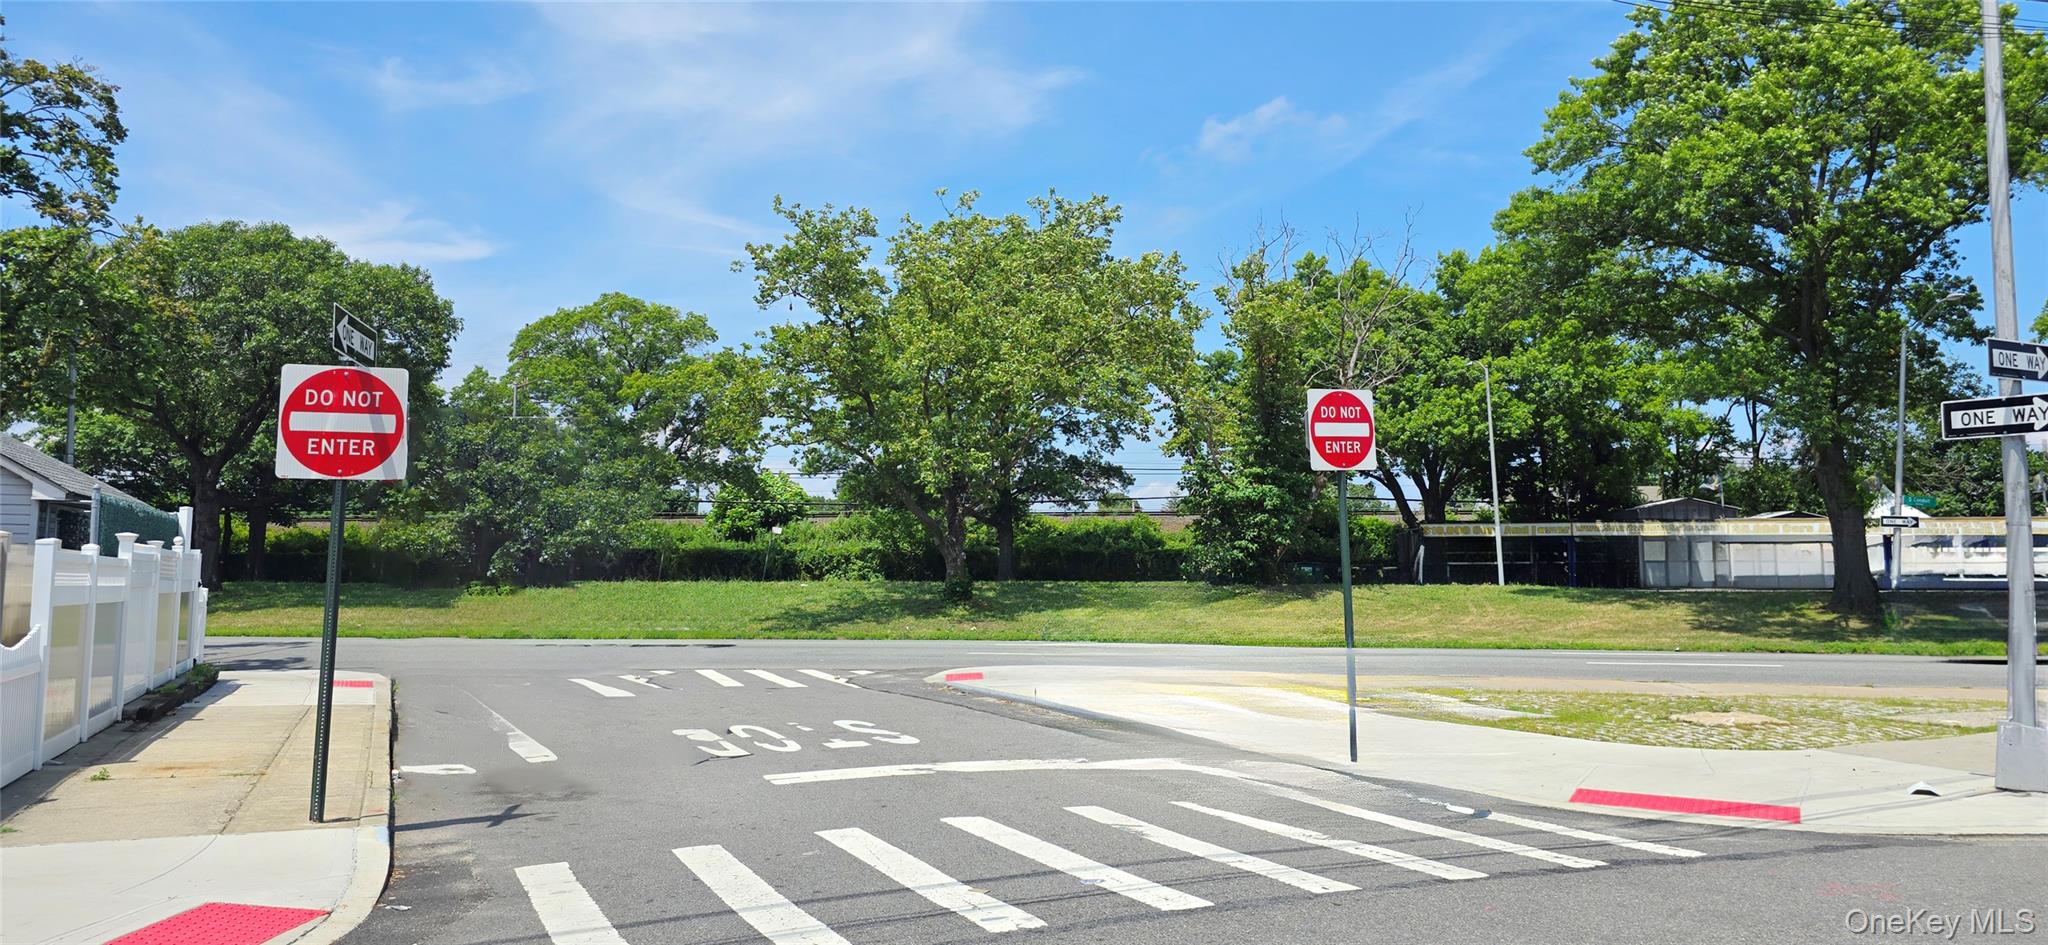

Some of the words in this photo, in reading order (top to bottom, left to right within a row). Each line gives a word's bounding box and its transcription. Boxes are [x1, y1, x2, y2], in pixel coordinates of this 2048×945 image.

[343, 324, 355, 346] ONE
[360, 334, 374, 357] WAY
[1998, 351, 2019, 367] ONE
[2026, 354, 2046, 370] WAY
[304, 389, 334, 407] DO
[342, 390, 384, 408] NOT
[1320, 406, 1336, 419] DO
[1340, 406, 1361, 419] NOT
[1960, 410, 1996, 427] ONE
[2012, 406, 2048, 422] WAY
[307, 438, 375, 456] ENTER
[1325, 441, 1361, 454] ENTER
